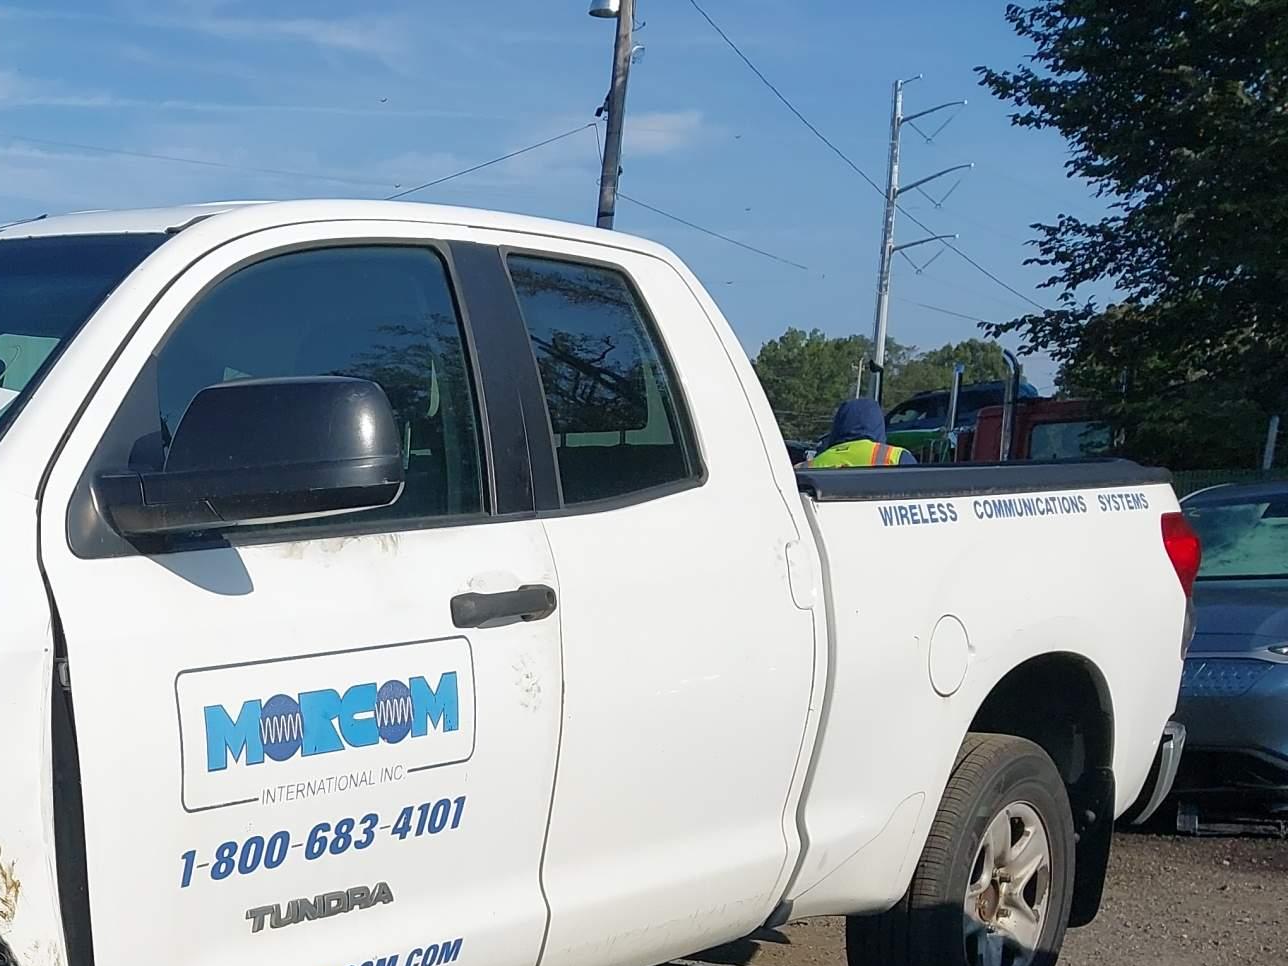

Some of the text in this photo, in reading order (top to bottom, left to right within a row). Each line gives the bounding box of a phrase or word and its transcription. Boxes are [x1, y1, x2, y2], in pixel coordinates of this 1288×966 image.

[878, 492, 1149, 527] WIRELESS COMMUNICATIONS SYSTEMS
[204, 671, 459, 772] MORCOM
[261, 769, 377, 805] INTERNATIONAL
[180, 796, 466, 888] 1-800-683-4101
[245, 882, 394, 933] TUNDRA
